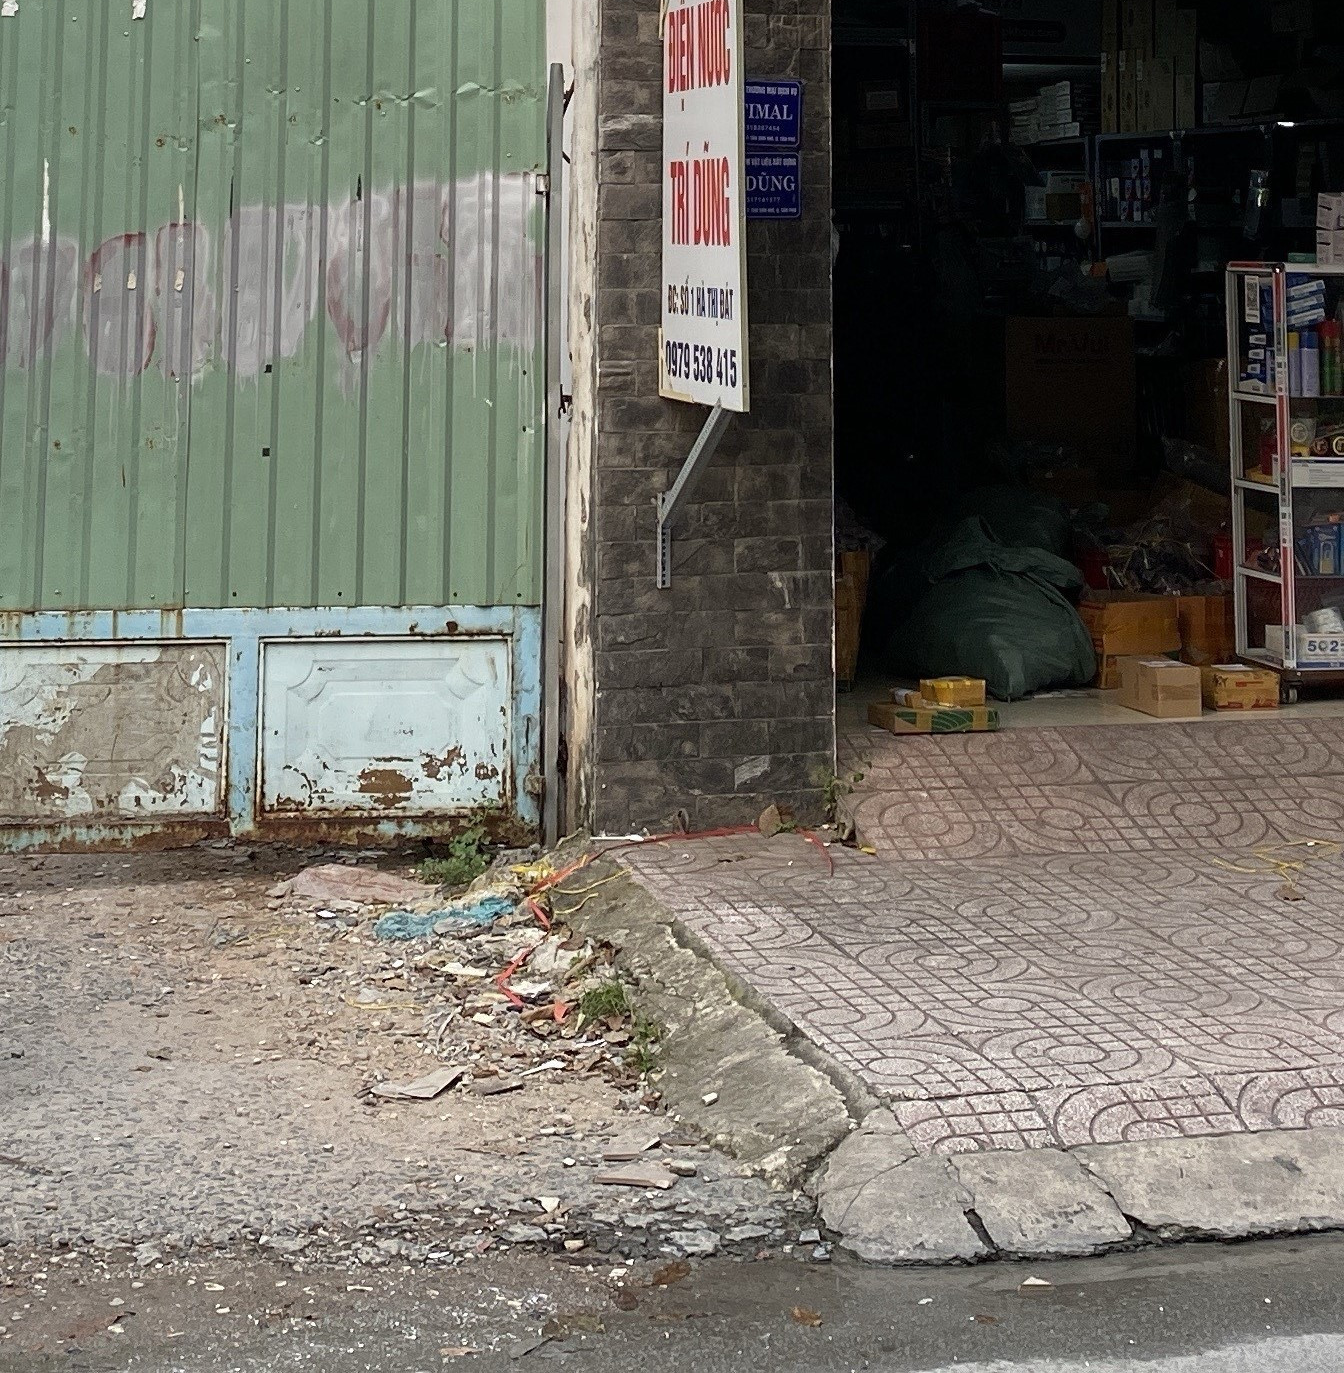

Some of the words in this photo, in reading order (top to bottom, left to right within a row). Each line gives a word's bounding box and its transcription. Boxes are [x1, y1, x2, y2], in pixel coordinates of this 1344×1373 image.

[745, 103, 793, 120] IMAL
[670, 140, 690, 246] TRÍ
[693, 141, 731, 248] DŨNG
[680, 275, 689, 316] SỐ
[697, 280, 706, 317] HÀ
[707, 287, 718, 326] THỊ
[666, 340, 690, 379] 0979
[693, 344, 713, 384] 538
[716, 347, 736, 388] 415
